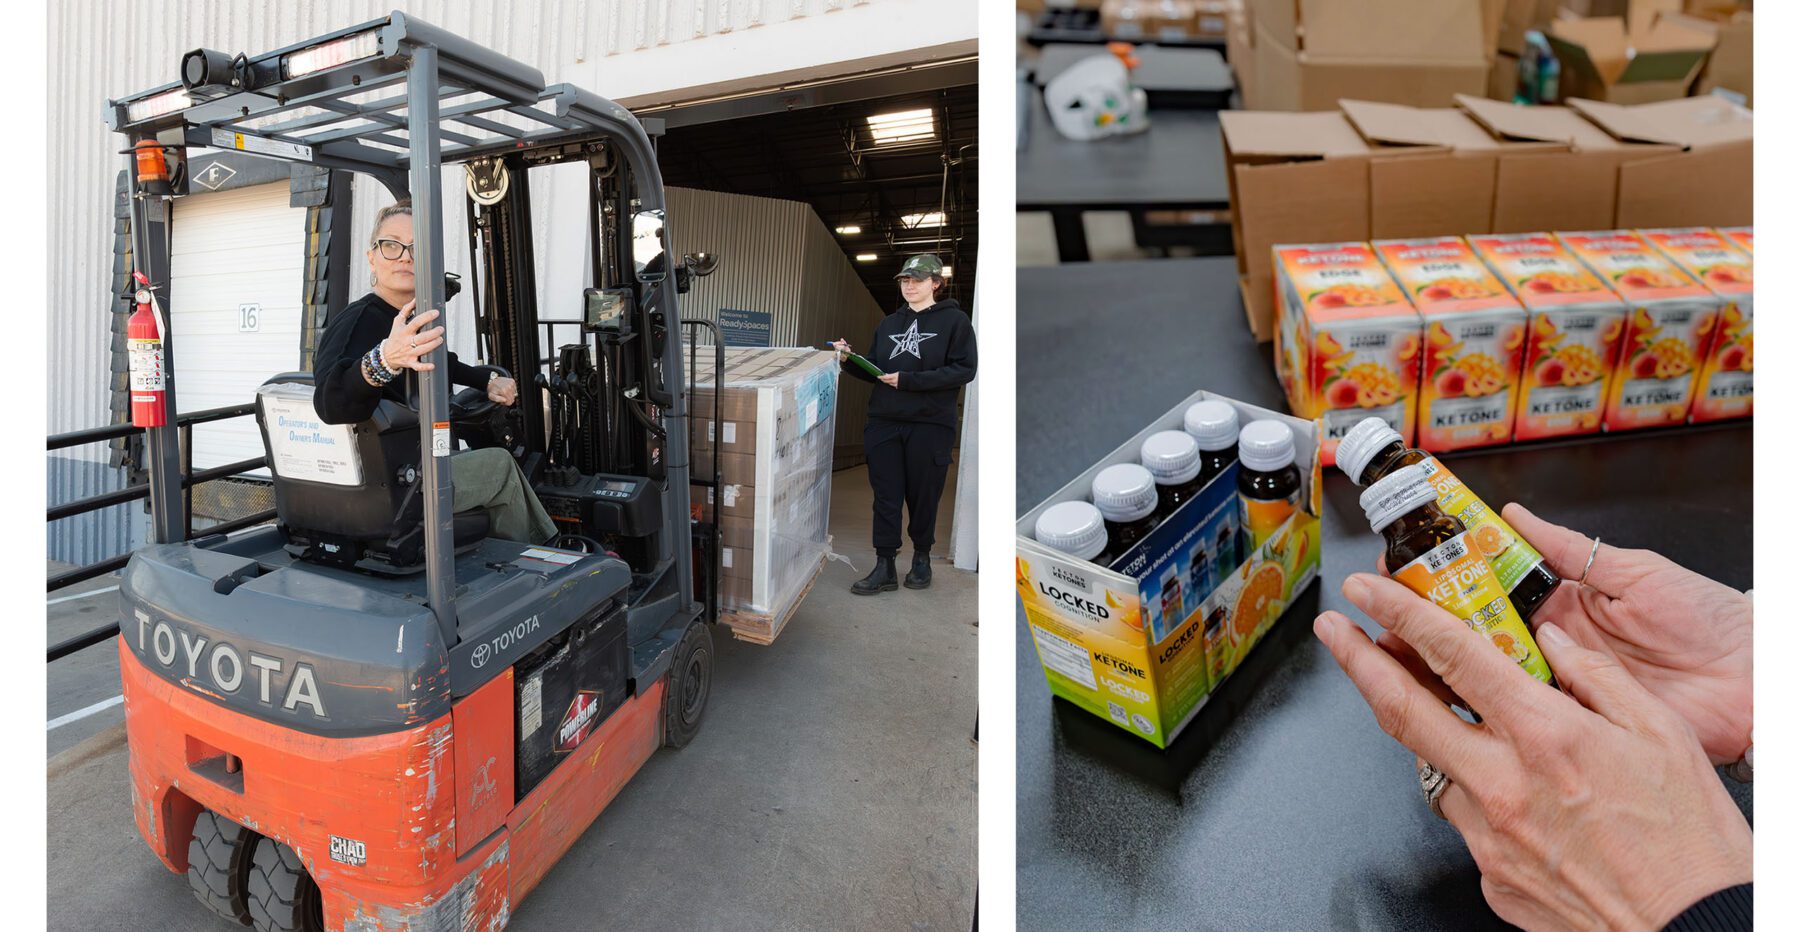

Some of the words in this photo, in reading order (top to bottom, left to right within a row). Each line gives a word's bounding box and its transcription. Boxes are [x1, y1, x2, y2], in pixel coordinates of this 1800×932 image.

[241, 307, 257, 328] 16
[1531, 399, 1593, 414] KETONE
[1624, 391, 1683, 405] KETONE
[1436, 409, 1502, 427] KETONE
[312, 432, 336, 445] MANUAL
[1428, 542, 1461, 562] TECTON
[1430, 546, 1464, 570] KETONES
[1052, 572, 1087, 589] KETONES
[1427, 560, 1489, 604] KETONE
[1435, 558, 1475, 585] LIPOSOMAL
[1039, 581, 1110, 619] LOCKED
[1054, 600, 1100, 623] COGNITION
[492, 614, 540, 655] TOYOTA
[1158, 620, 1200, 664] LOCKED
[134, 609, 327, 719] TOYOTA
[1094, 652, 1146, 680] KETONE
[1100, 675, 1150, 703] LOCKED
[560, 697, 598, 746] POWERLINE
[330, 835, 367, 860] CHAD
